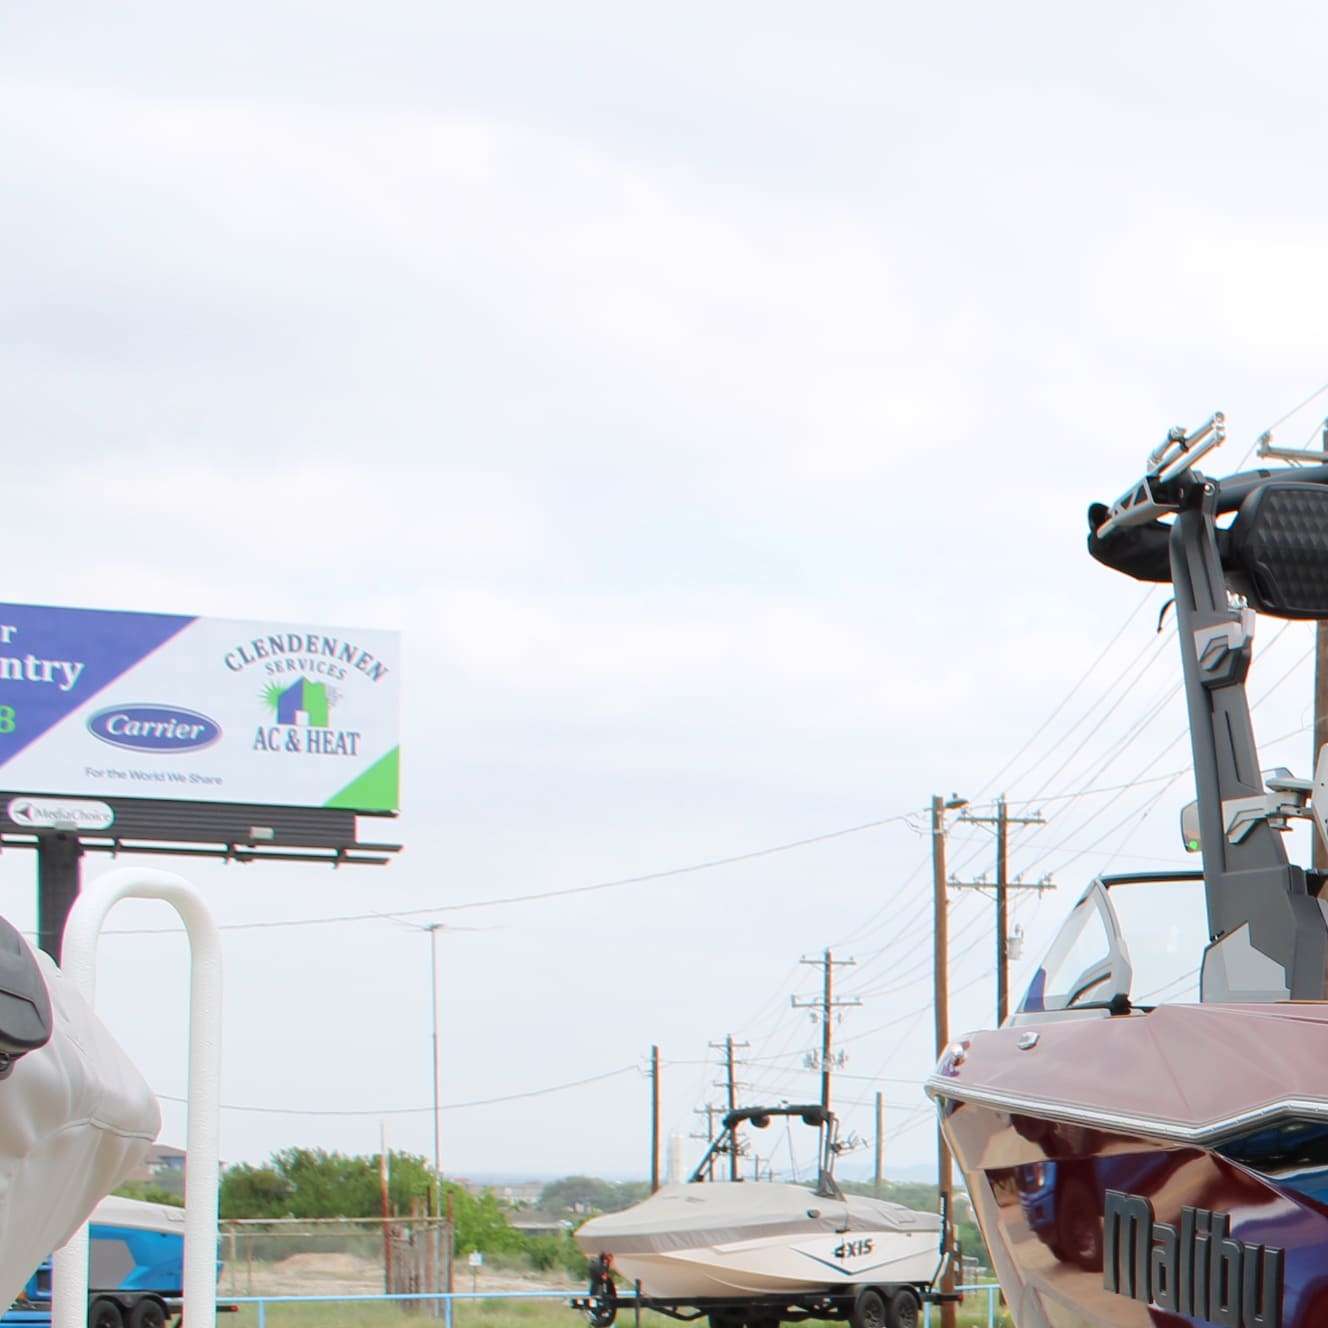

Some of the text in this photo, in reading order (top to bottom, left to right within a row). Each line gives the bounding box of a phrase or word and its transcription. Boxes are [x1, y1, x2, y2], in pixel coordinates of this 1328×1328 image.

[224, 632, 389, 682] CLENDENNEN
[264, 658, 348, 681] SERVICES
[106, 713, 205, 740] Carrier
[253, 725, 361, 757] AC & HEAT
[84, 766, 224, 786] For the World We Share
